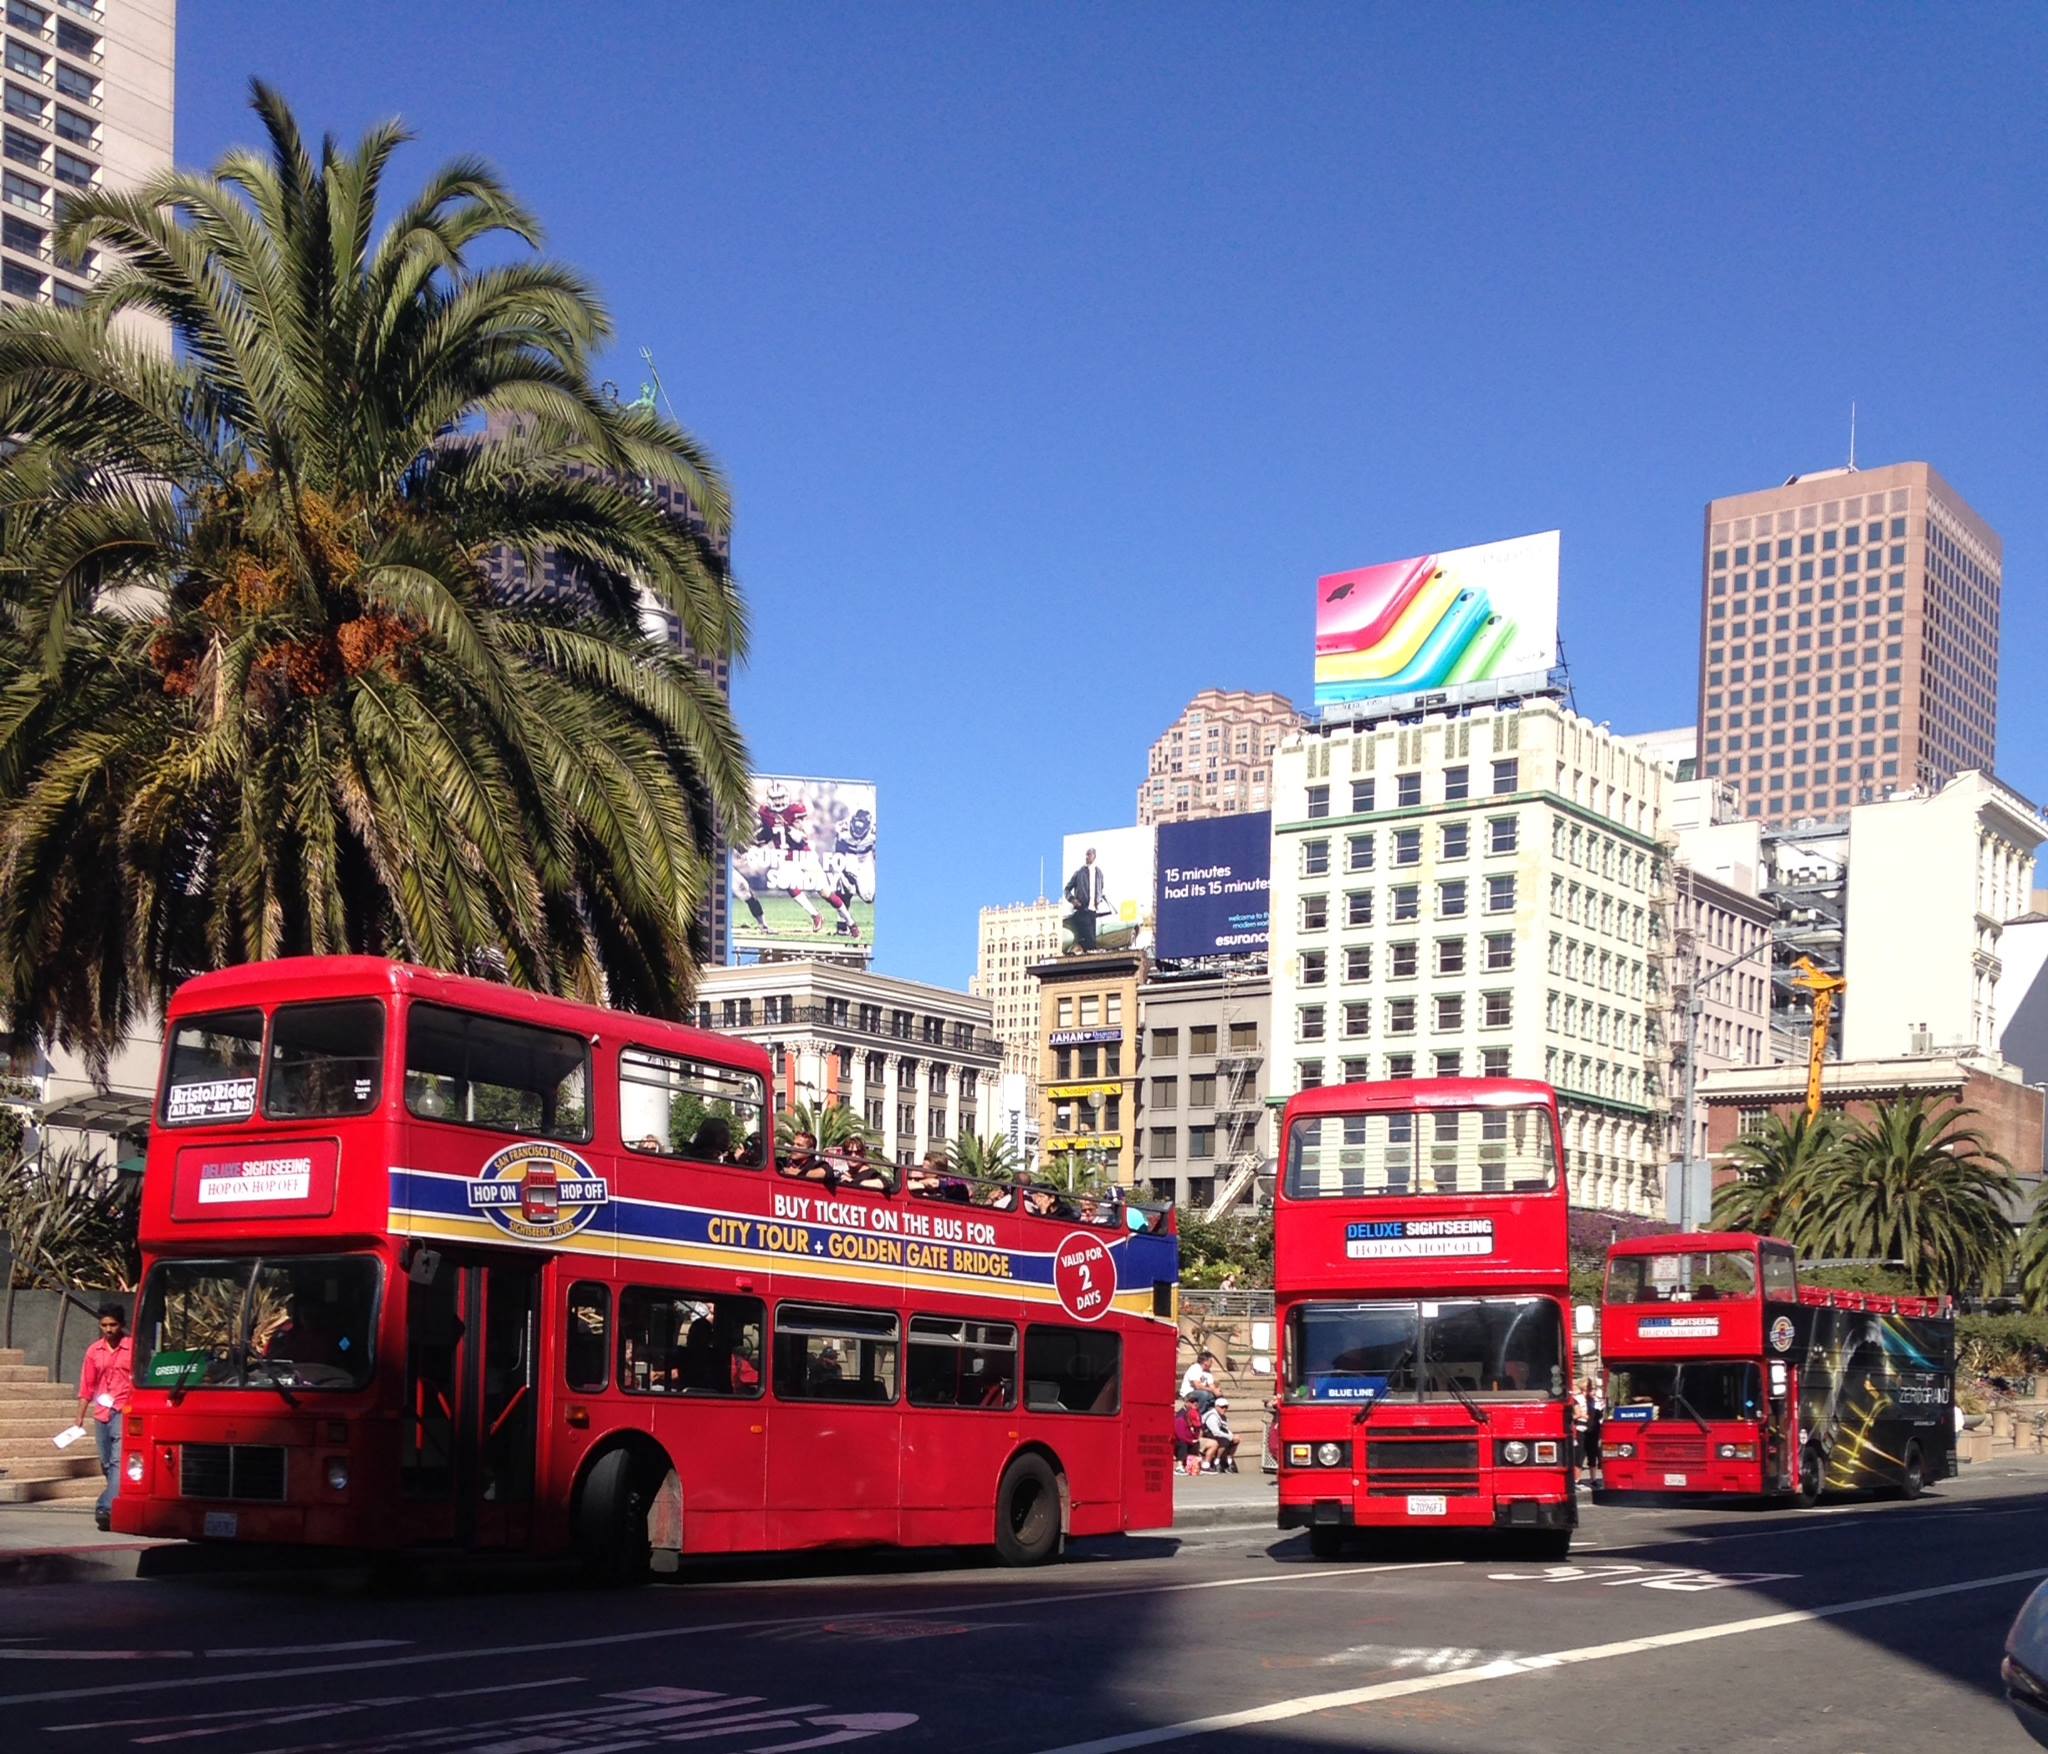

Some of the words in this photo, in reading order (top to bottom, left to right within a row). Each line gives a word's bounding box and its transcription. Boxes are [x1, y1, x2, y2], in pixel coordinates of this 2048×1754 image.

[1165, 868, 1180, 882] 15
[1182, 865, 1232, 881] minutes
[1165, 884, 1189, 899] had
[1191, 884, 1206, 897] its
[1208, 881, 1222, 895] 15
[1050, 1031, 1084, 1043] JAHAN
[172, 1104, 186, 1116] All
[187, 1103, 206, 1117] Day
[212, 1101, 232, 1114] Any
[232, 1099, 250, 1111] Bus
[494, 1153, 509, 1170] SAN
[509, 1147, 549, 1162] FRANCISCO
[550, 1148, 577, 1168] DELUXE
[202, 1162, 242, 1179] DELUXE
[242, 1158, 311, 1176] SIGHTSEEING
[208, 1182, 231, 1196] HOP
[233, 1181, 249, 1194] ON
[252, 1180, 275, 1193] HOP
[277, 1178, 298, 1192] OFF
[474, 1186, 498, 1202] HOP
[501, 1185, 517, 1201] ON
[561, 1184, 582, 1199] HOP
[585, 1183, 604, 1198] OFF
[509, 1221, 552, 1237] SIGHTSEEING
[554, 1220, 575, 1235] TOURS
[774, 1194, 811, 1220] BUY
[815, 1200, 867, 1228] TICKET
[871, 1208, 898, 1231] ON
[902, 1212, 930, 1236] THE
[933, 1217, 963, 1241] BUS
[966, 1222, 996, 1246] FOR
[1347, 1223, 1402, 1239] DELUXE
[1405, 1220, 1492, 1236] SIGHTSEEING
[708, 1217, 751, 1246] CITY
[756, 1223, 809, 1254] TOUR
[814, 1241, 824, 1254] +
[828, 1232, 901, 1264] GOLDEN
[906, 1243, 948, 1269] GATE
[953, 1249, 1013, 1278] BRIDGE.
[1355, 1244, 1387, 1256] HOP
[1390, 1243, 1412, 1255] ON
[1418, 1242, 1451, 1254] HOP
[1061, 1252, 1085, 1268] VALID
[1085, 1247, 1103, 1261] FOR
[1078, 1264, 1093, 1292] 2
[1076, 1289, 1102, 1310] DAYS
[155, 1364, 180, 1376] GREEN
[1328, 1388, 1352, 1397] BLUE
[1354, 1388, 1374, 1397] LINE
[1487, 1565, 1804, 1591] BUS
